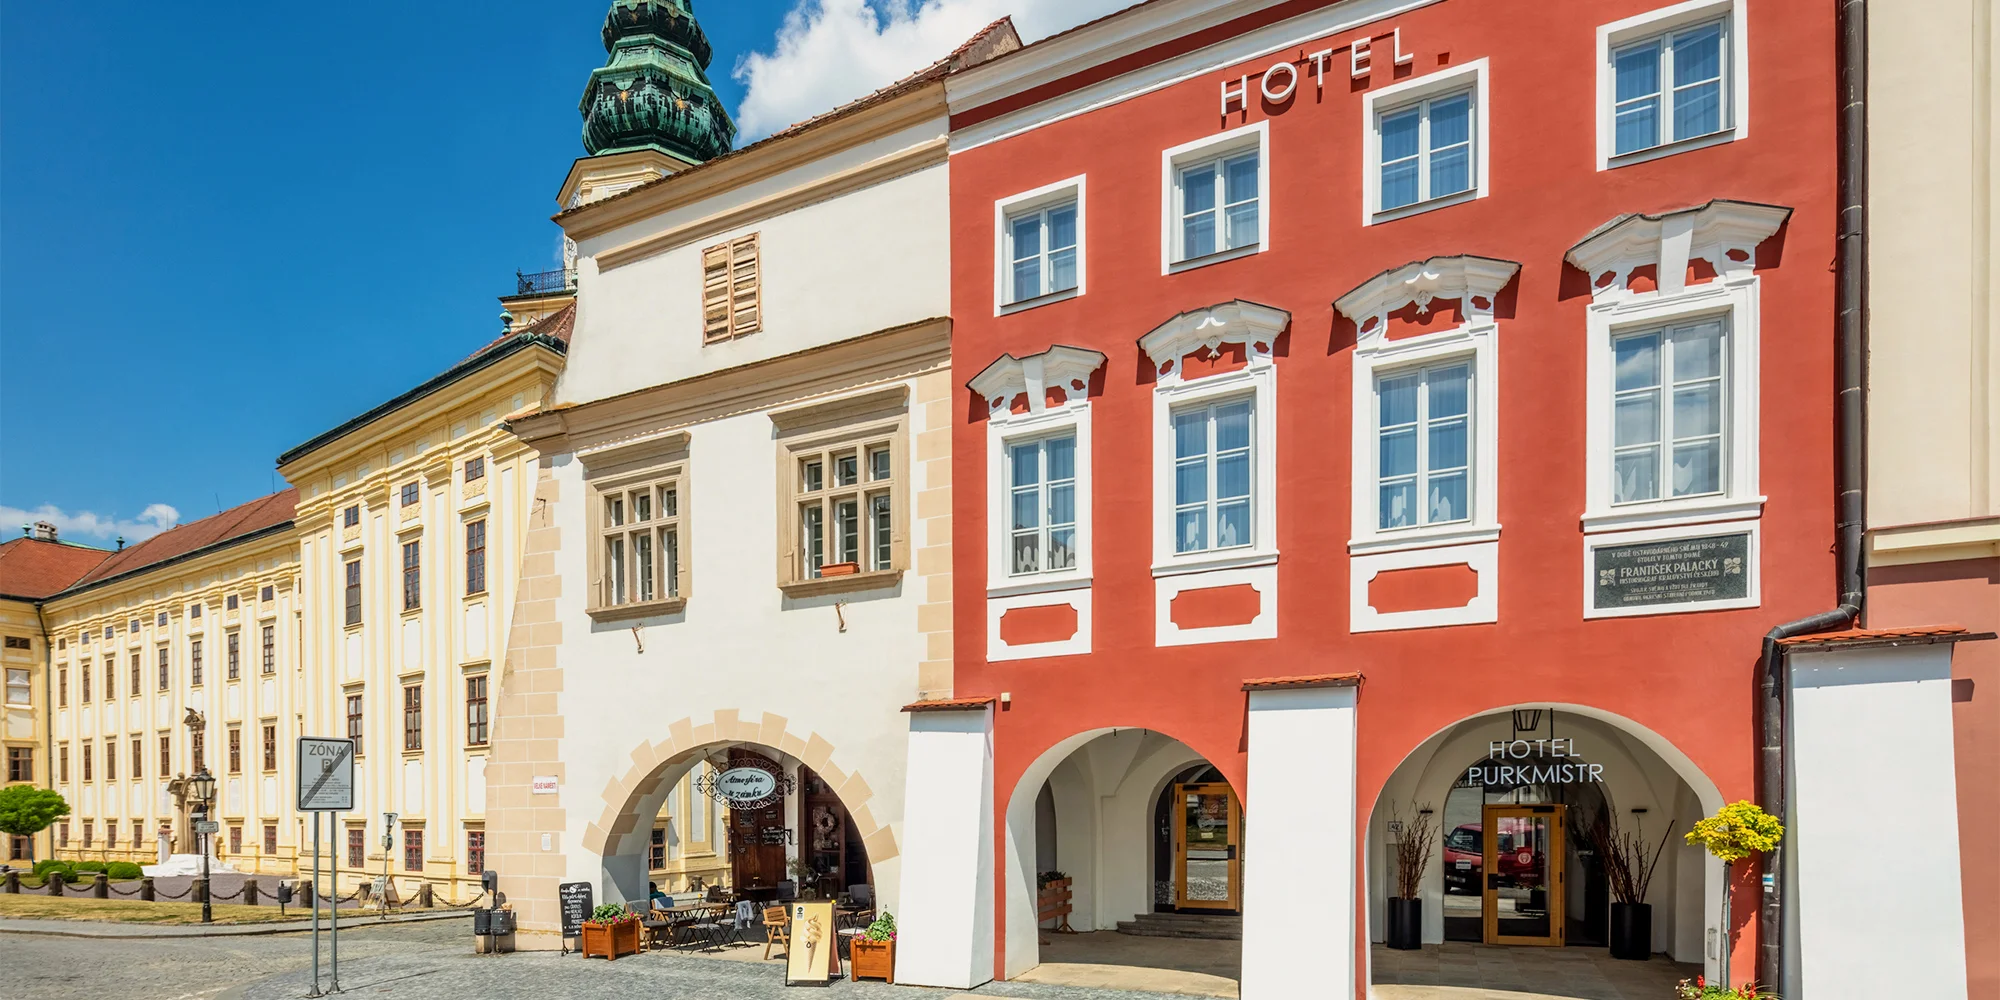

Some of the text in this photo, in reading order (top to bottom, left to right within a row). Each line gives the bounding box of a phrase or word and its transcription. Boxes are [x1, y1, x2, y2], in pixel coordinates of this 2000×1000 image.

[1221, 27, 1413, 116] HOTEL
[1620, 557, 1718, 578] FRANTIŠEK PALACKÝ
[1620, 575, 1657, 584] HISTORIOGRAF
[1694, 570, 1720, 578] ČESKÉHO
[309, 743, 344, 756] ZÓNA
[1490, 738, 1580, 759] HOTEL
[725, 774, 766, 786] Atmosféra
[1468, 764, 1604, 785] PURKMISTR
[735, 787, 762, 798] zámku
